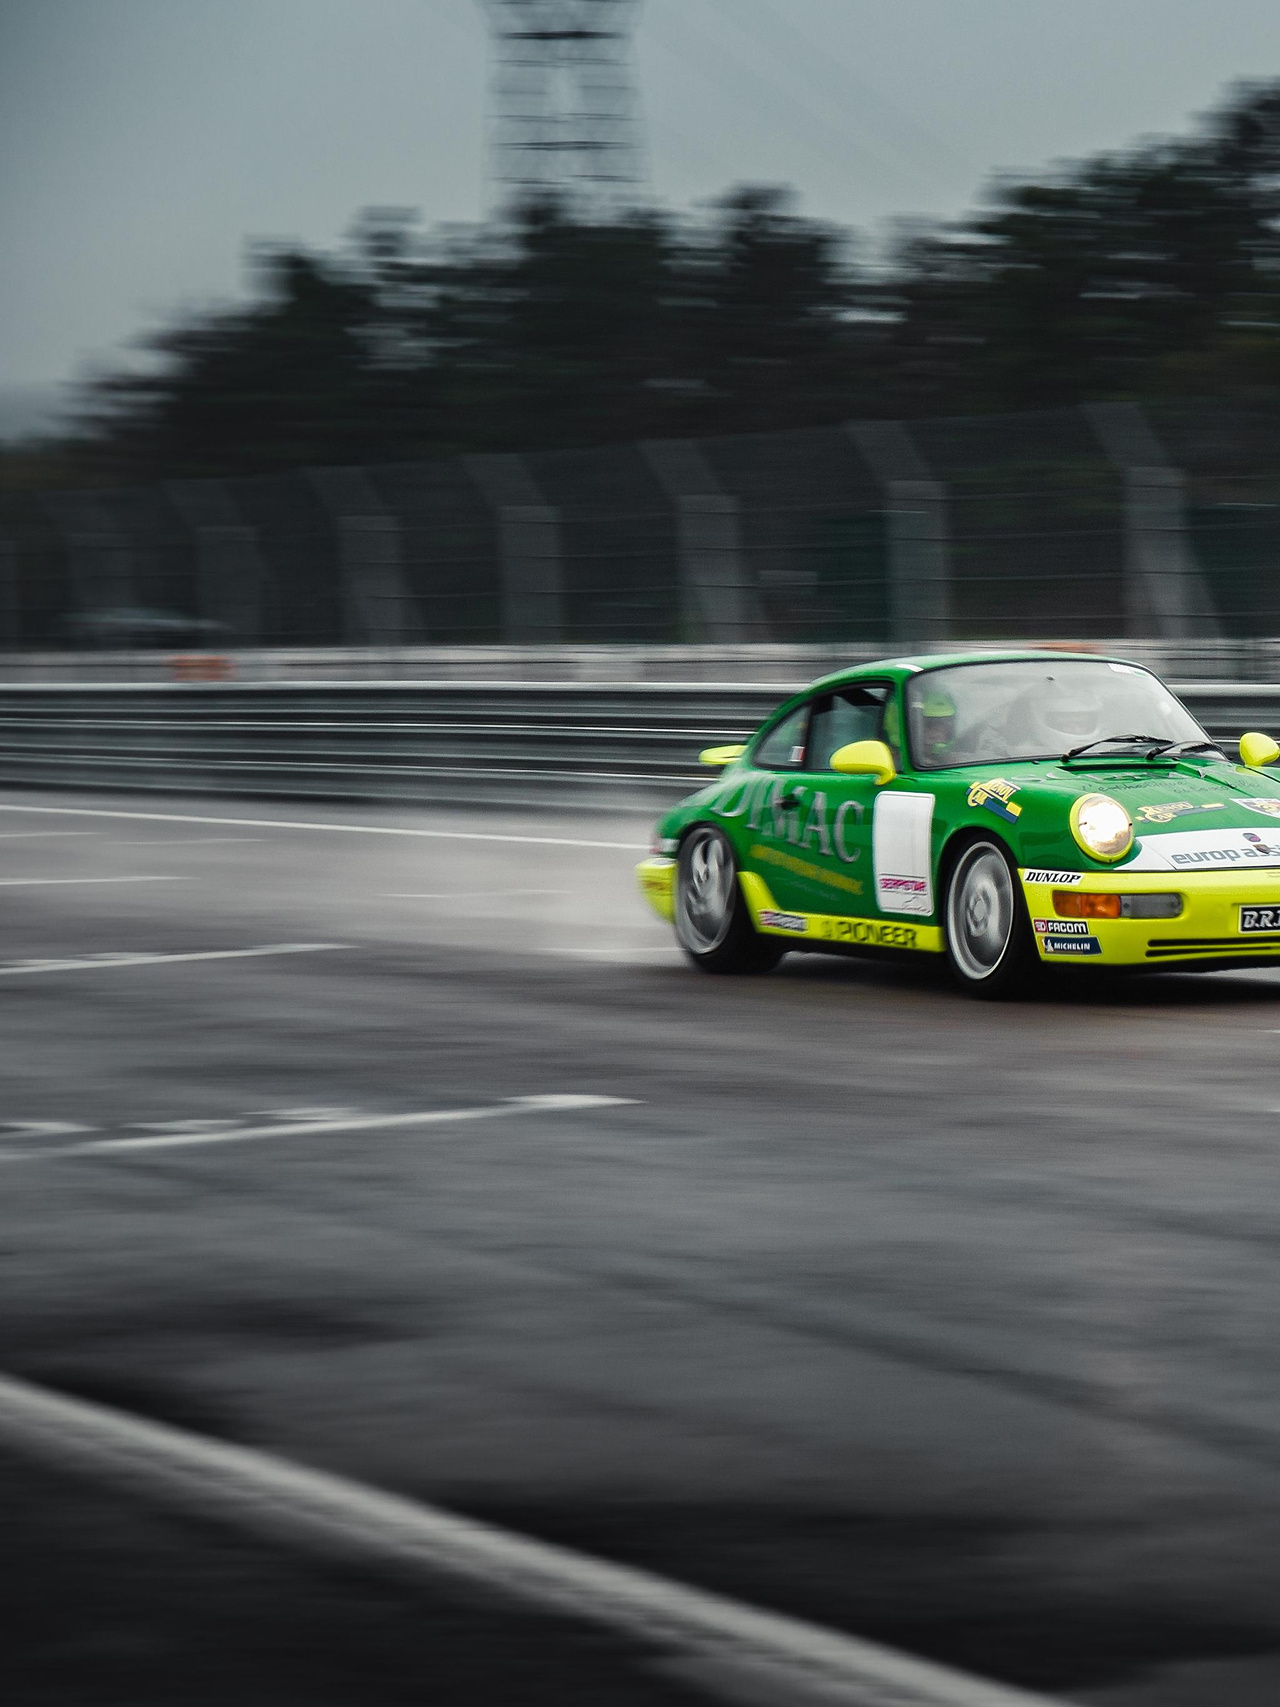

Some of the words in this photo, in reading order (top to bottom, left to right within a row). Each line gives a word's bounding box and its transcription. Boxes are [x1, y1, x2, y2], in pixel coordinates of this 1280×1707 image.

[1171, 849, 1241, 865] europ
[1025, 871, 1081, 883] DUNLOP
[1047, 922, 1087, 933] FACOM
[838, 921, 917, 947] PIONEER
[1053, 942, 1091, 950] MICHELIN
